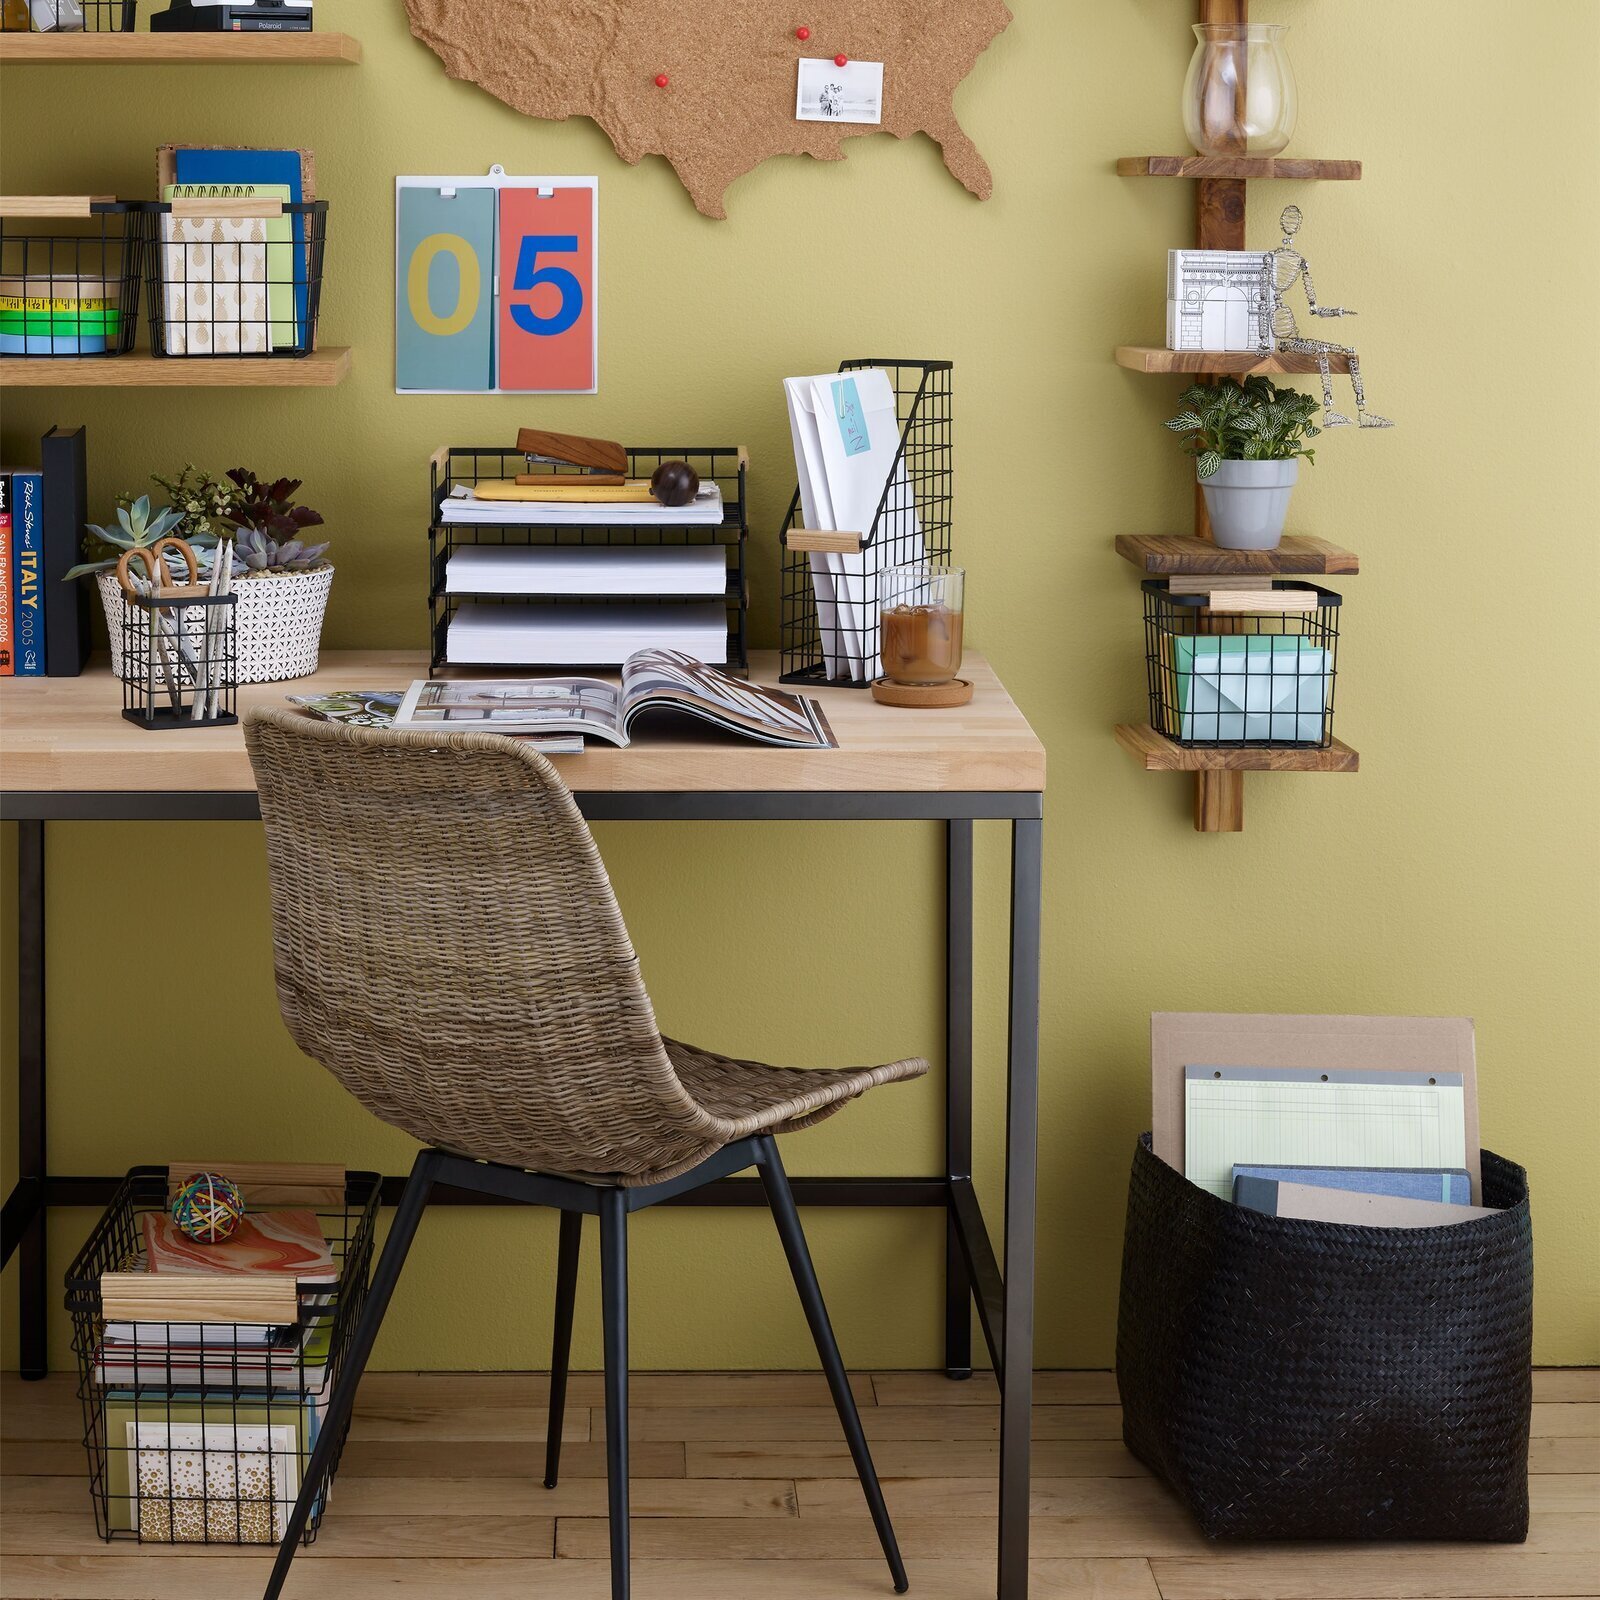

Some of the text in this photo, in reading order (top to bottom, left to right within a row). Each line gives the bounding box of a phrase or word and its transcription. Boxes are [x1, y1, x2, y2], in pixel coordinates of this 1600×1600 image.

[24, 480, 34, 509] Rick
[21, 551, 38, 645] ITALY 2005
[0, 618, 8, 642] 2006
